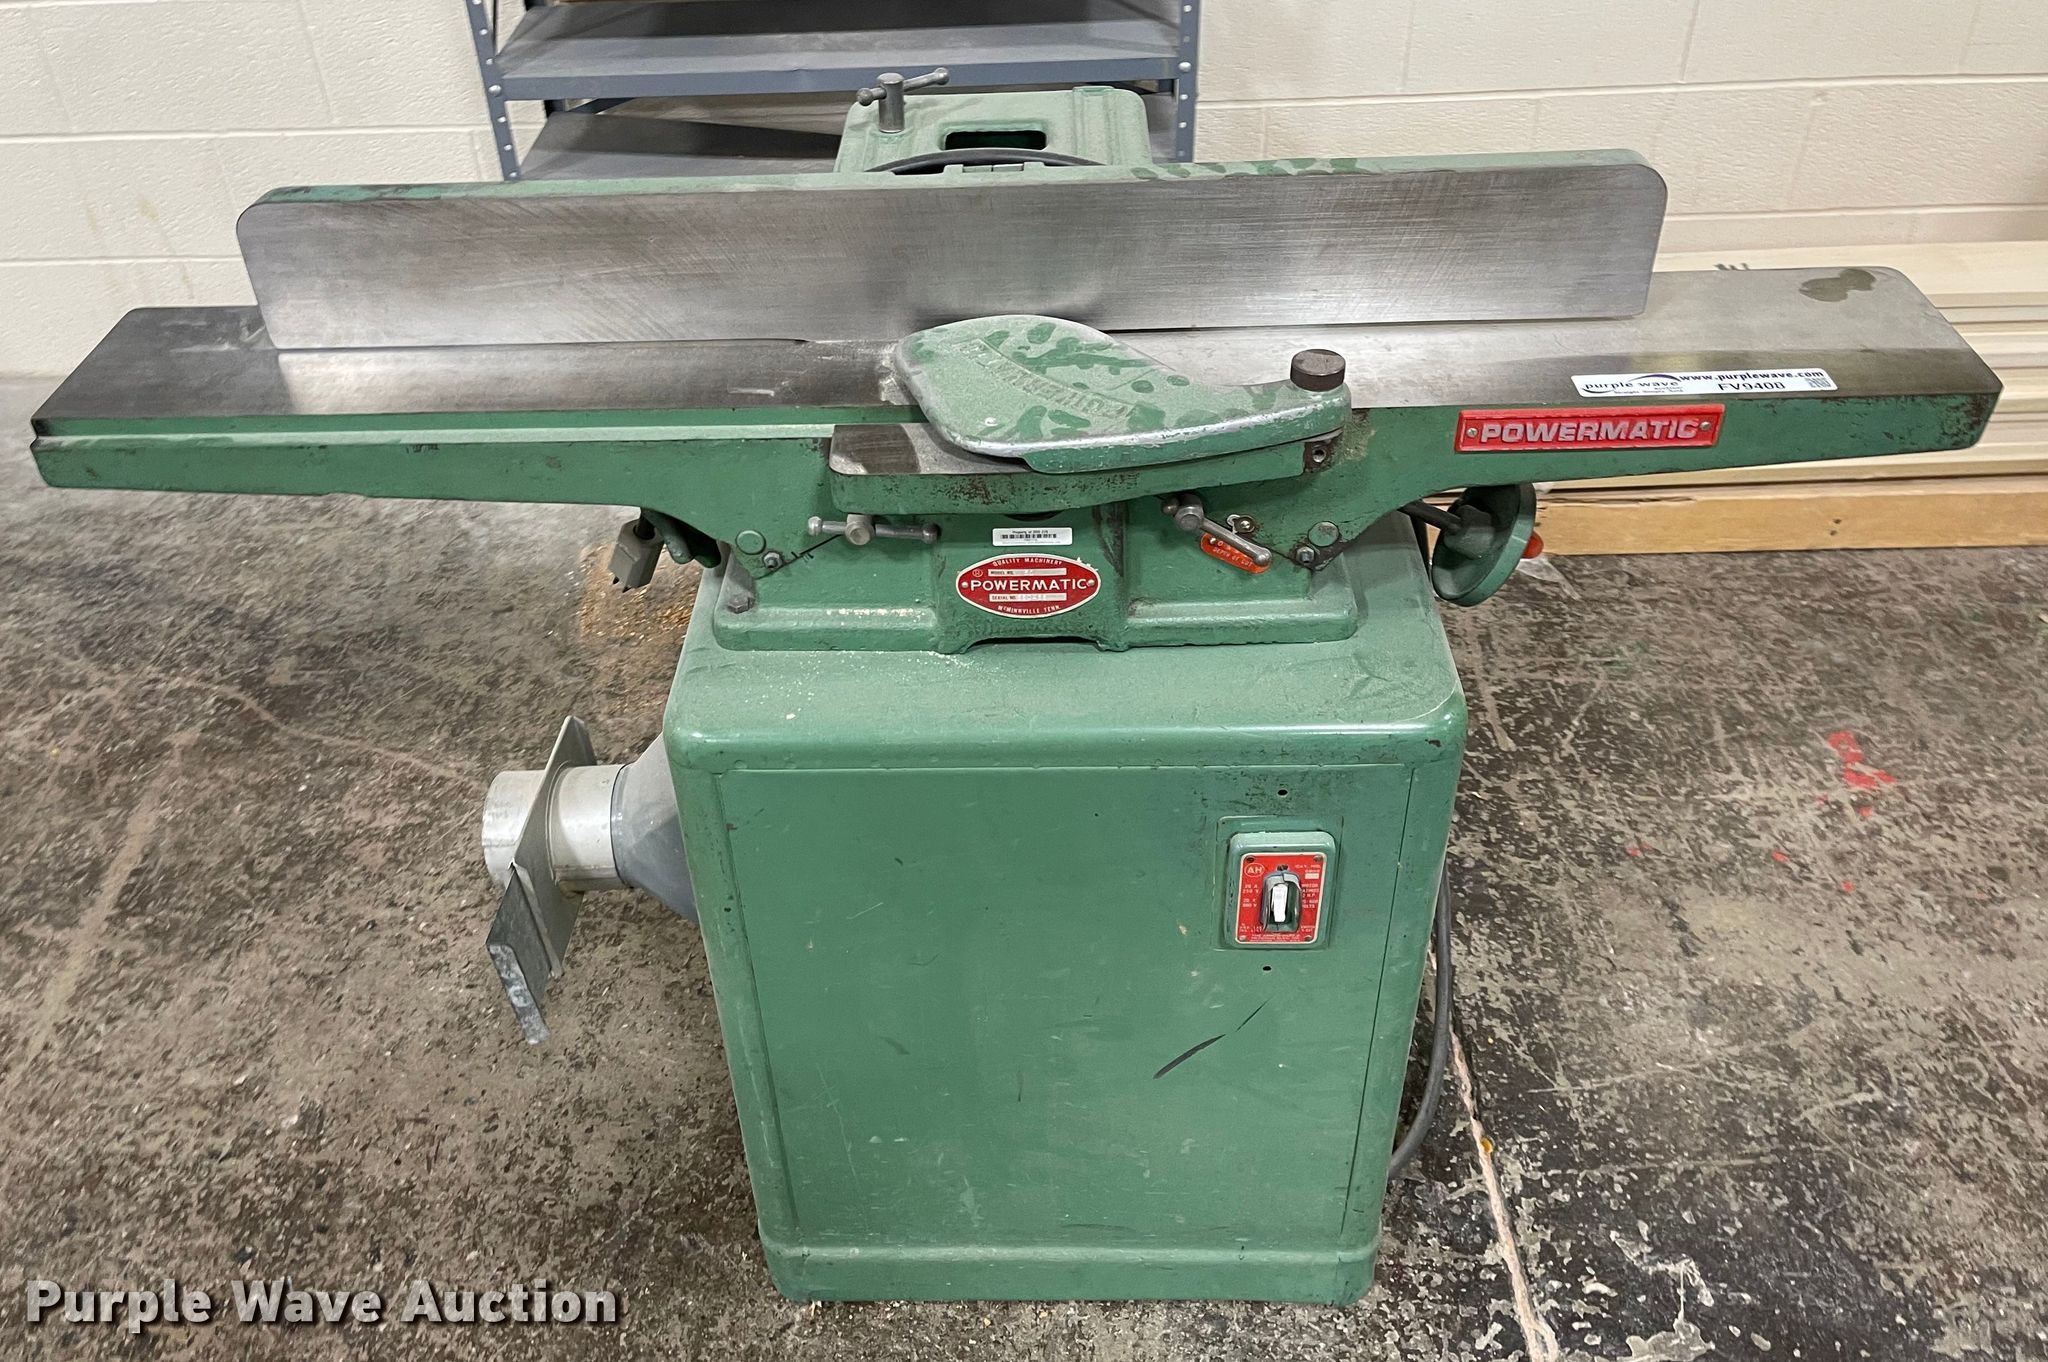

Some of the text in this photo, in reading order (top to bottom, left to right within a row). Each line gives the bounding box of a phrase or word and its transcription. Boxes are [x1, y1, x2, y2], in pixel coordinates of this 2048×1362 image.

[1679, 371, 1824, 382] www.purplewave.com
[1481, 419, 1700, 443] POWERMATIC
[992, 557, 1062, 567] QUALITY MACHINERY
[970, 579, 1087, 592] POWERMATIC
[1247, 866, 1263, 874] AH
